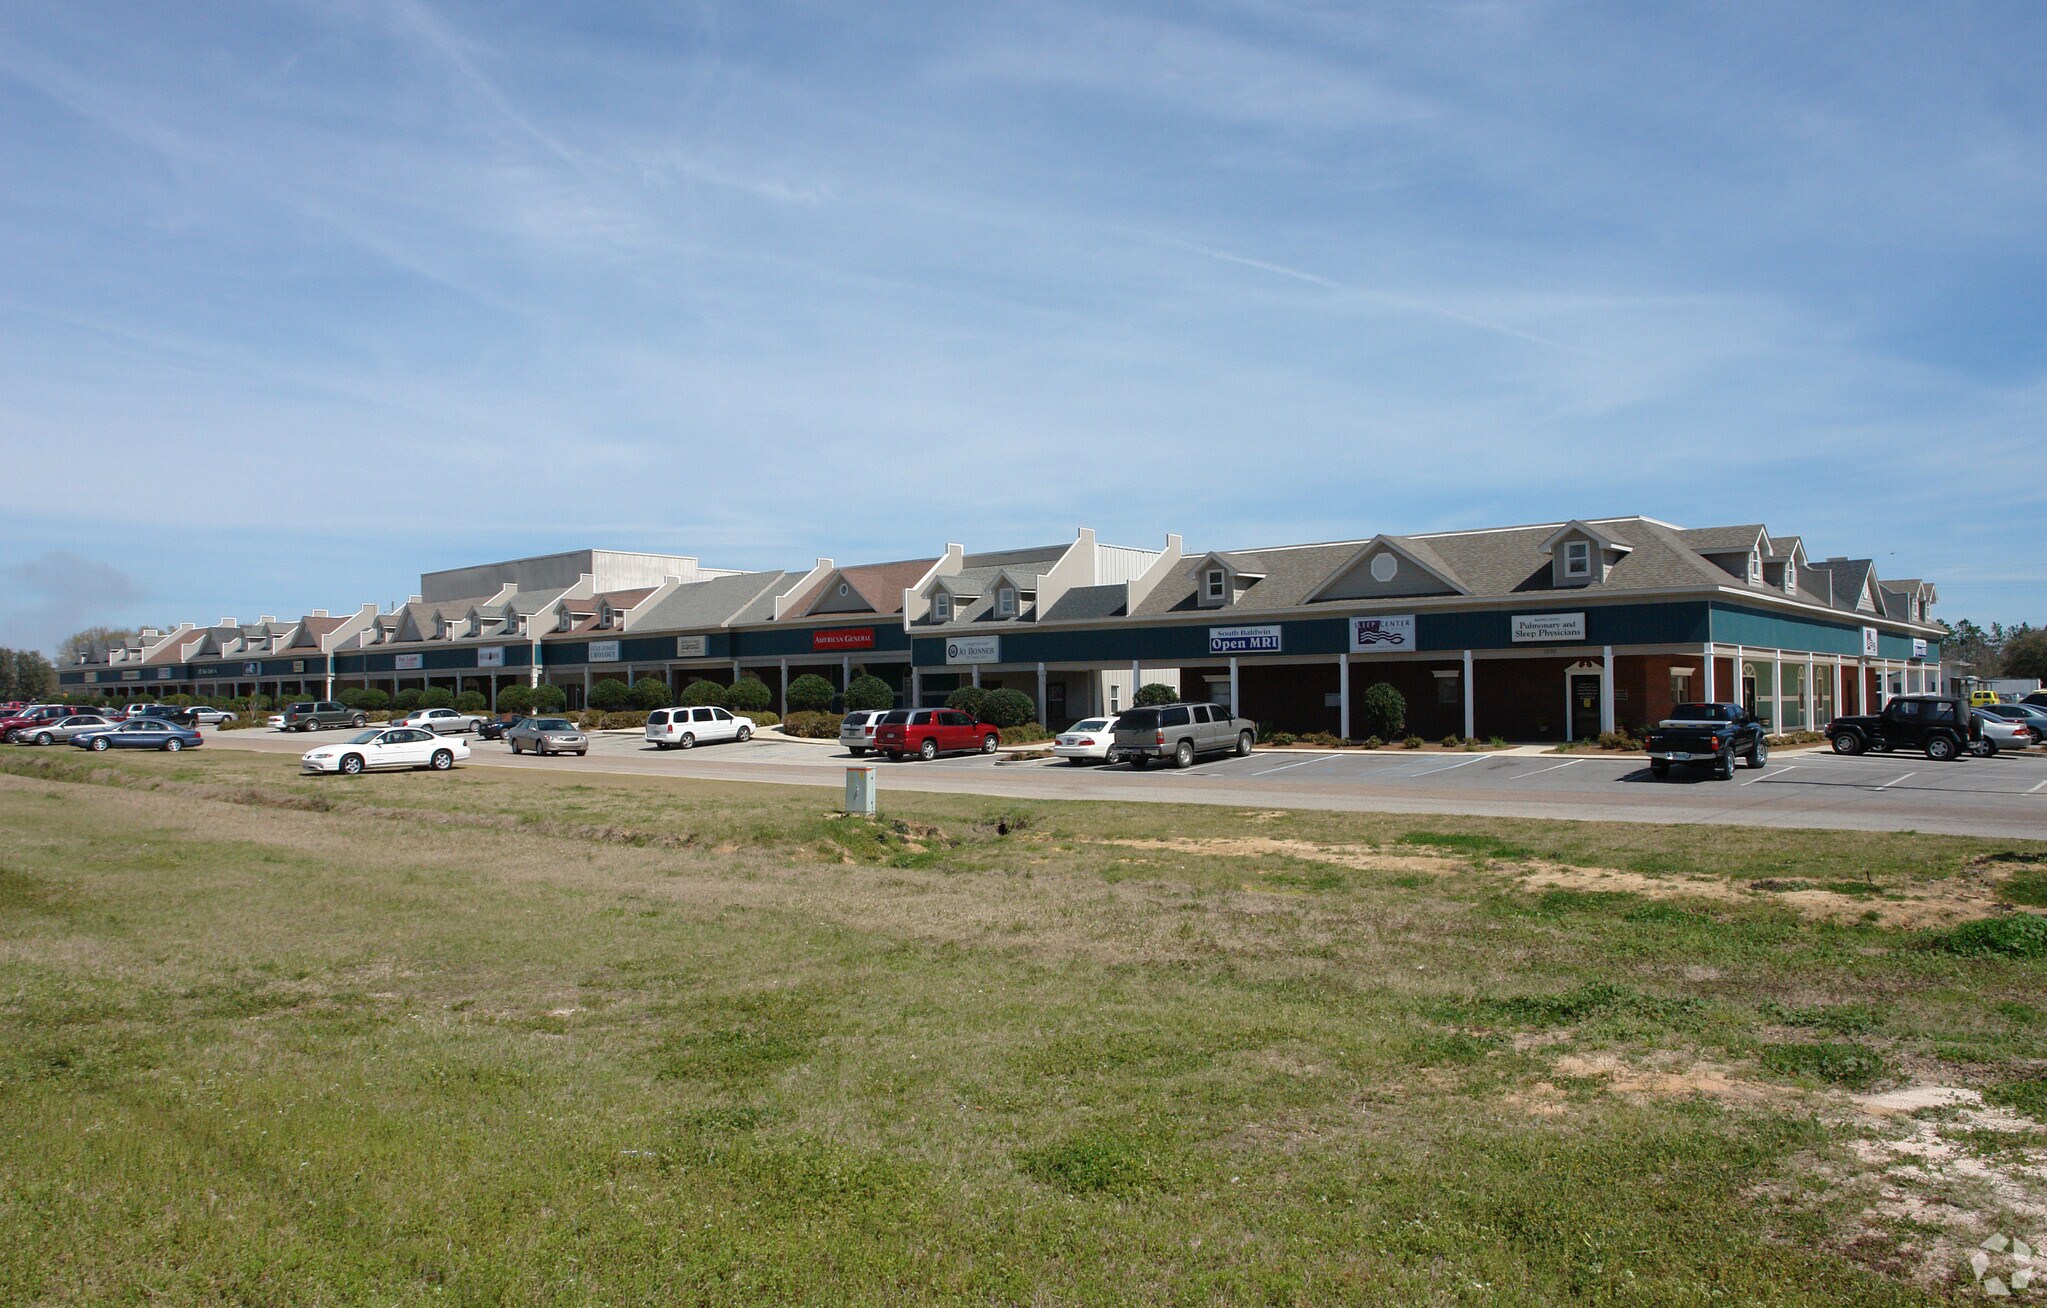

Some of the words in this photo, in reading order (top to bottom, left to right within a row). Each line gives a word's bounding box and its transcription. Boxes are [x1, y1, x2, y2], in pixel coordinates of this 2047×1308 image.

[1354, 621, 1376, 629] SLEEP
[1519, 621, 1560, 630] Pulmonary
[1240, 628, 1271, 636] Baldwin
[1514, 629, 1536, 638] Sleep
[1538, 628, 1581, 637] Physicians
[1212, 638, 1246, 651] Open
[1249, 637, 1278, 648] MRI
[968, 647, 995, 655] BONNER
